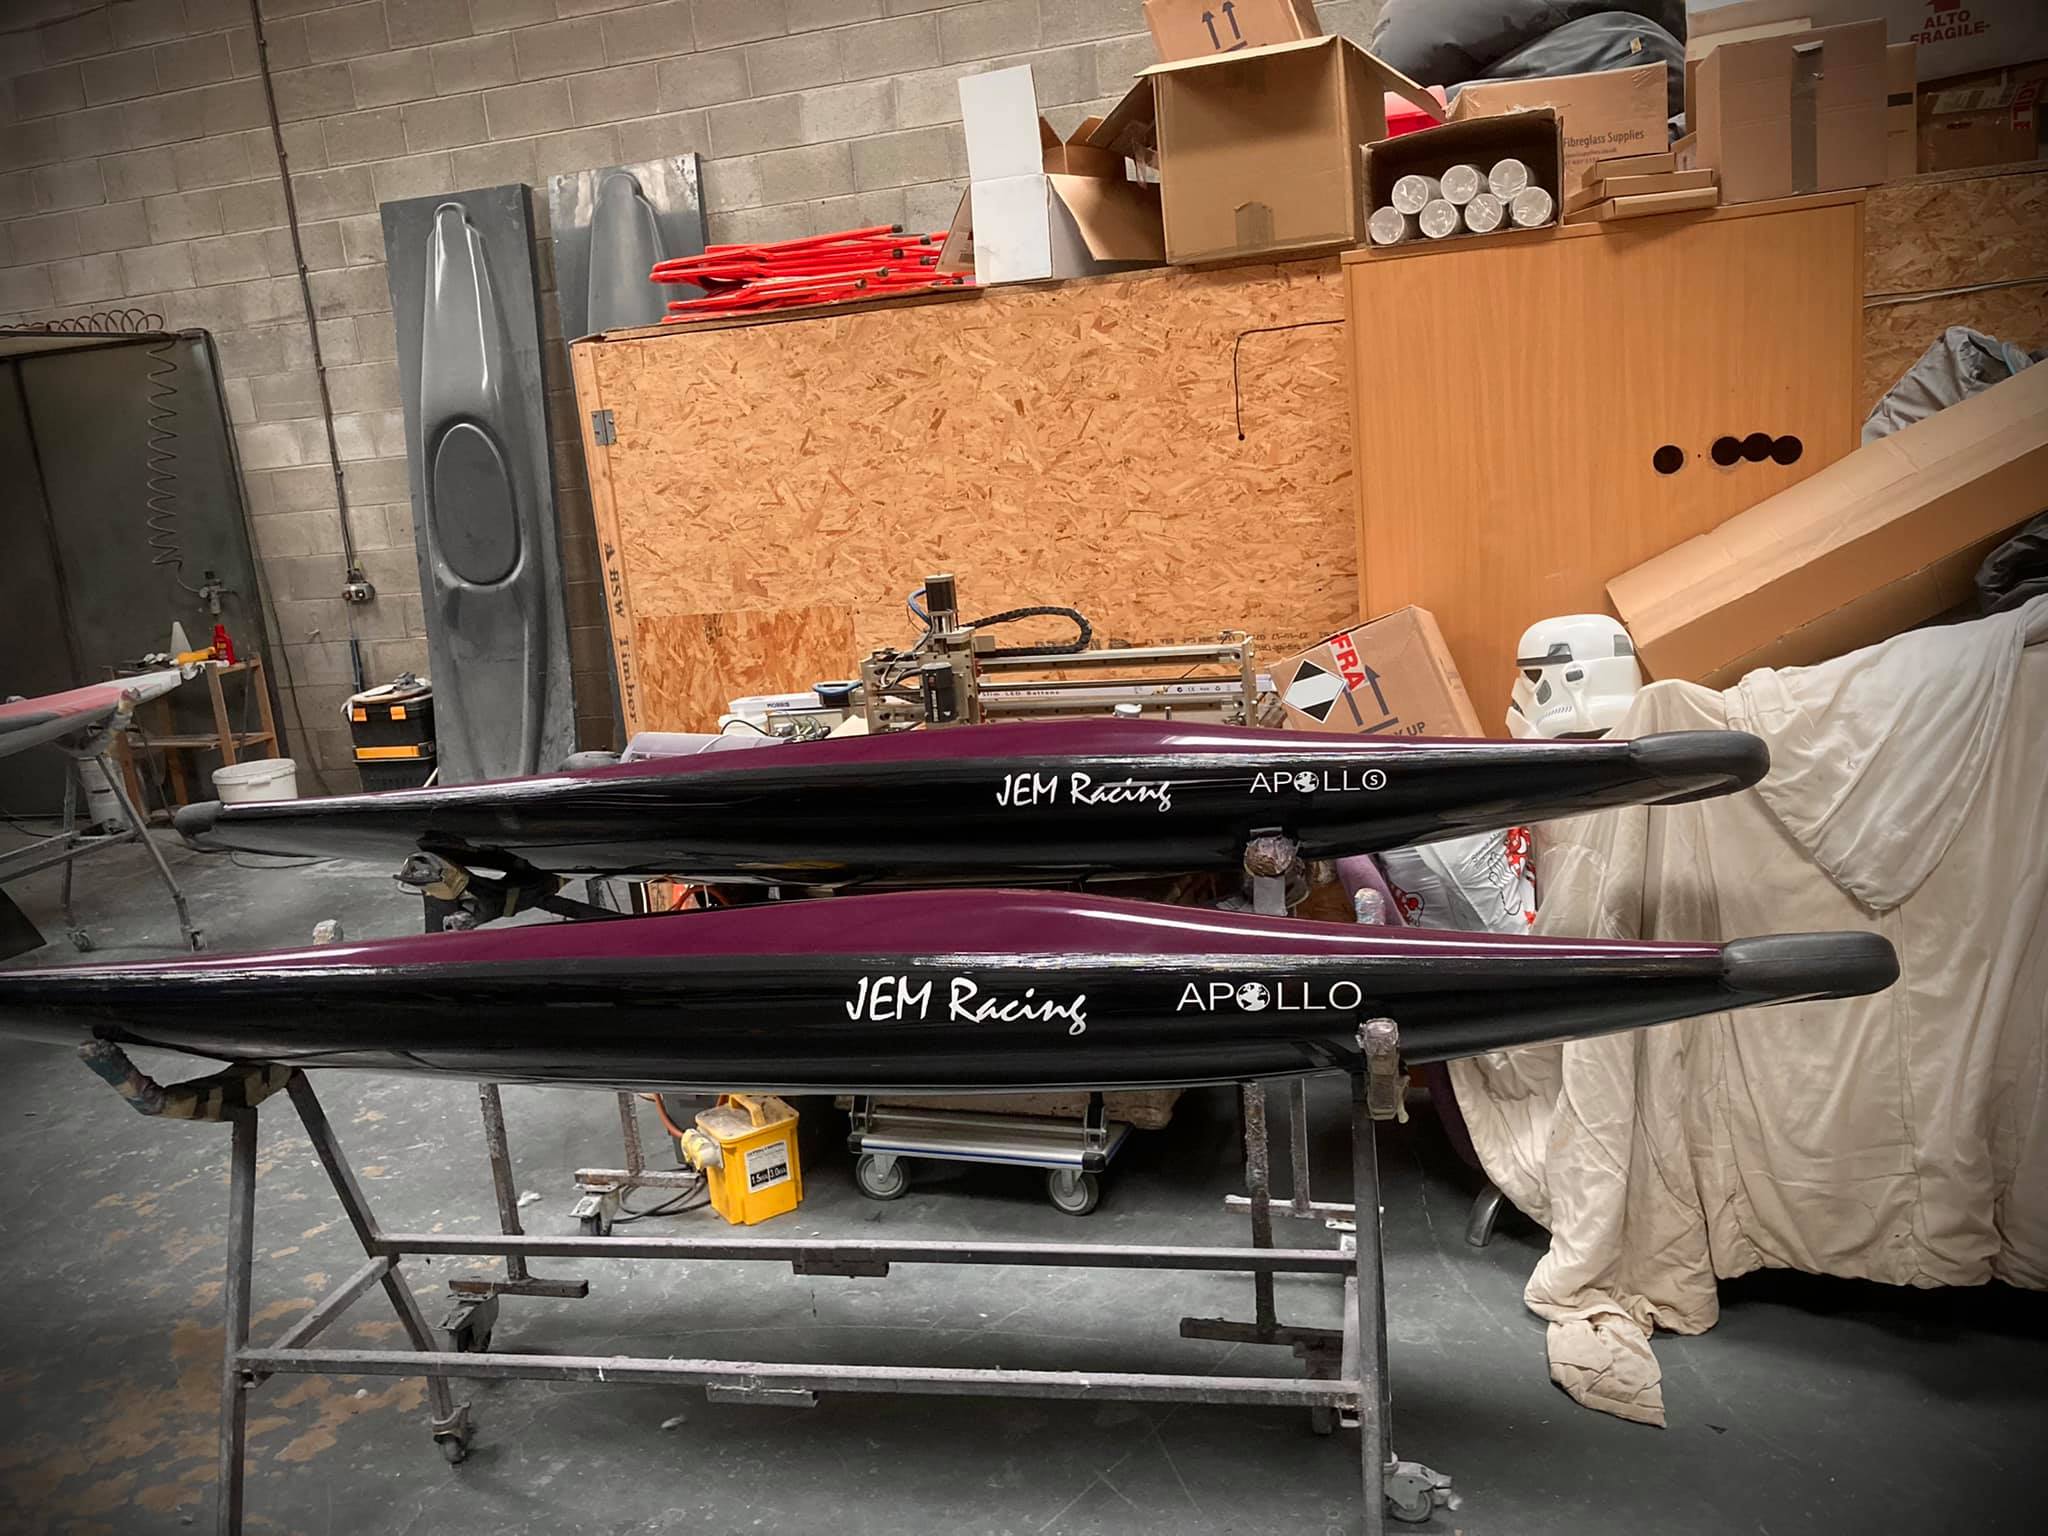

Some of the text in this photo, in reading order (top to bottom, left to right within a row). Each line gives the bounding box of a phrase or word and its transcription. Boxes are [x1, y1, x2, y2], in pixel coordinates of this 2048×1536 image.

[1924, 10, 1971, 29] ALTO
[1563, 129, 1645, 148] Fibreglass Supplies
[609, 570, 626, 618] BSW
[617, 635, 638, 723] Timber
[1407, 721, 1426, 737] UP
[996, 771, 1172, 812] JEM Racing
[846, 975, 1087, 1036] JEM Racing
